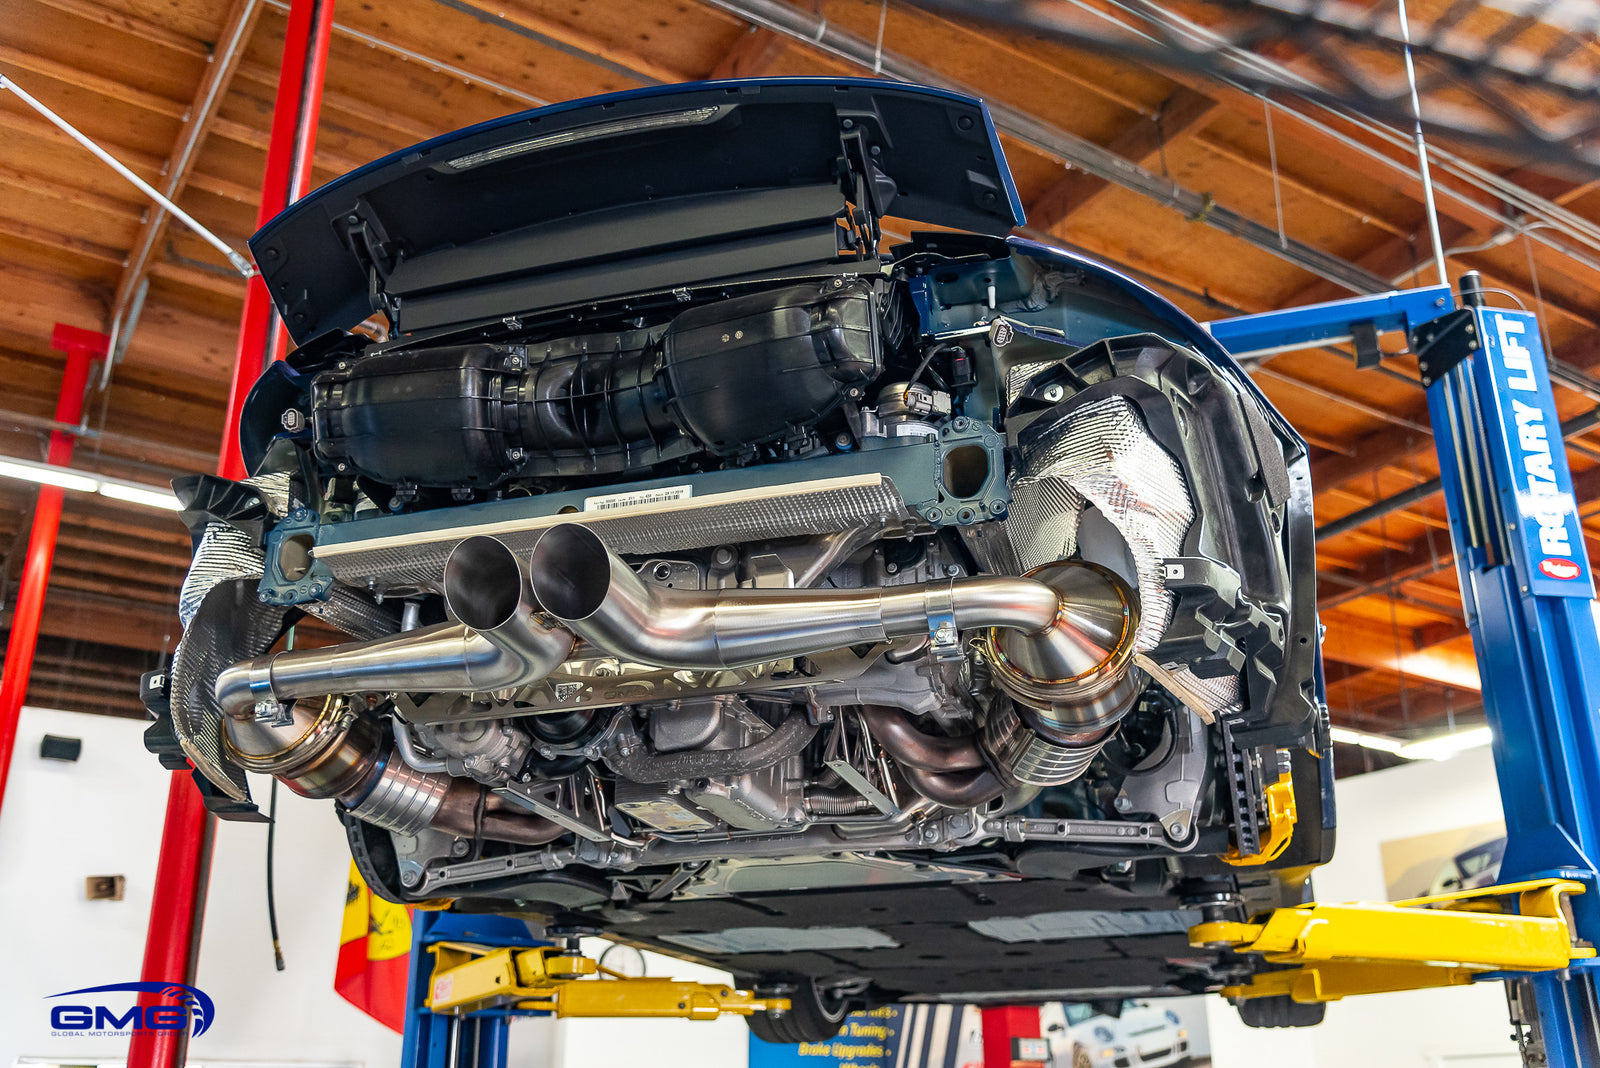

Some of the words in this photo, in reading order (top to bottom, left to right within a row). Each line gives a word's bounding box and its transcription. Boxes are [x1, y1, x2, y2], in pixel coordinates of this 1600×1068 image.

[1495, 313, 1538, 392] LIFT
[850, 1022, 887, 1041] Tuning
[798, 1041, 831, 1057] Brake
[832, 1042, 884, 1060] Upgrades
